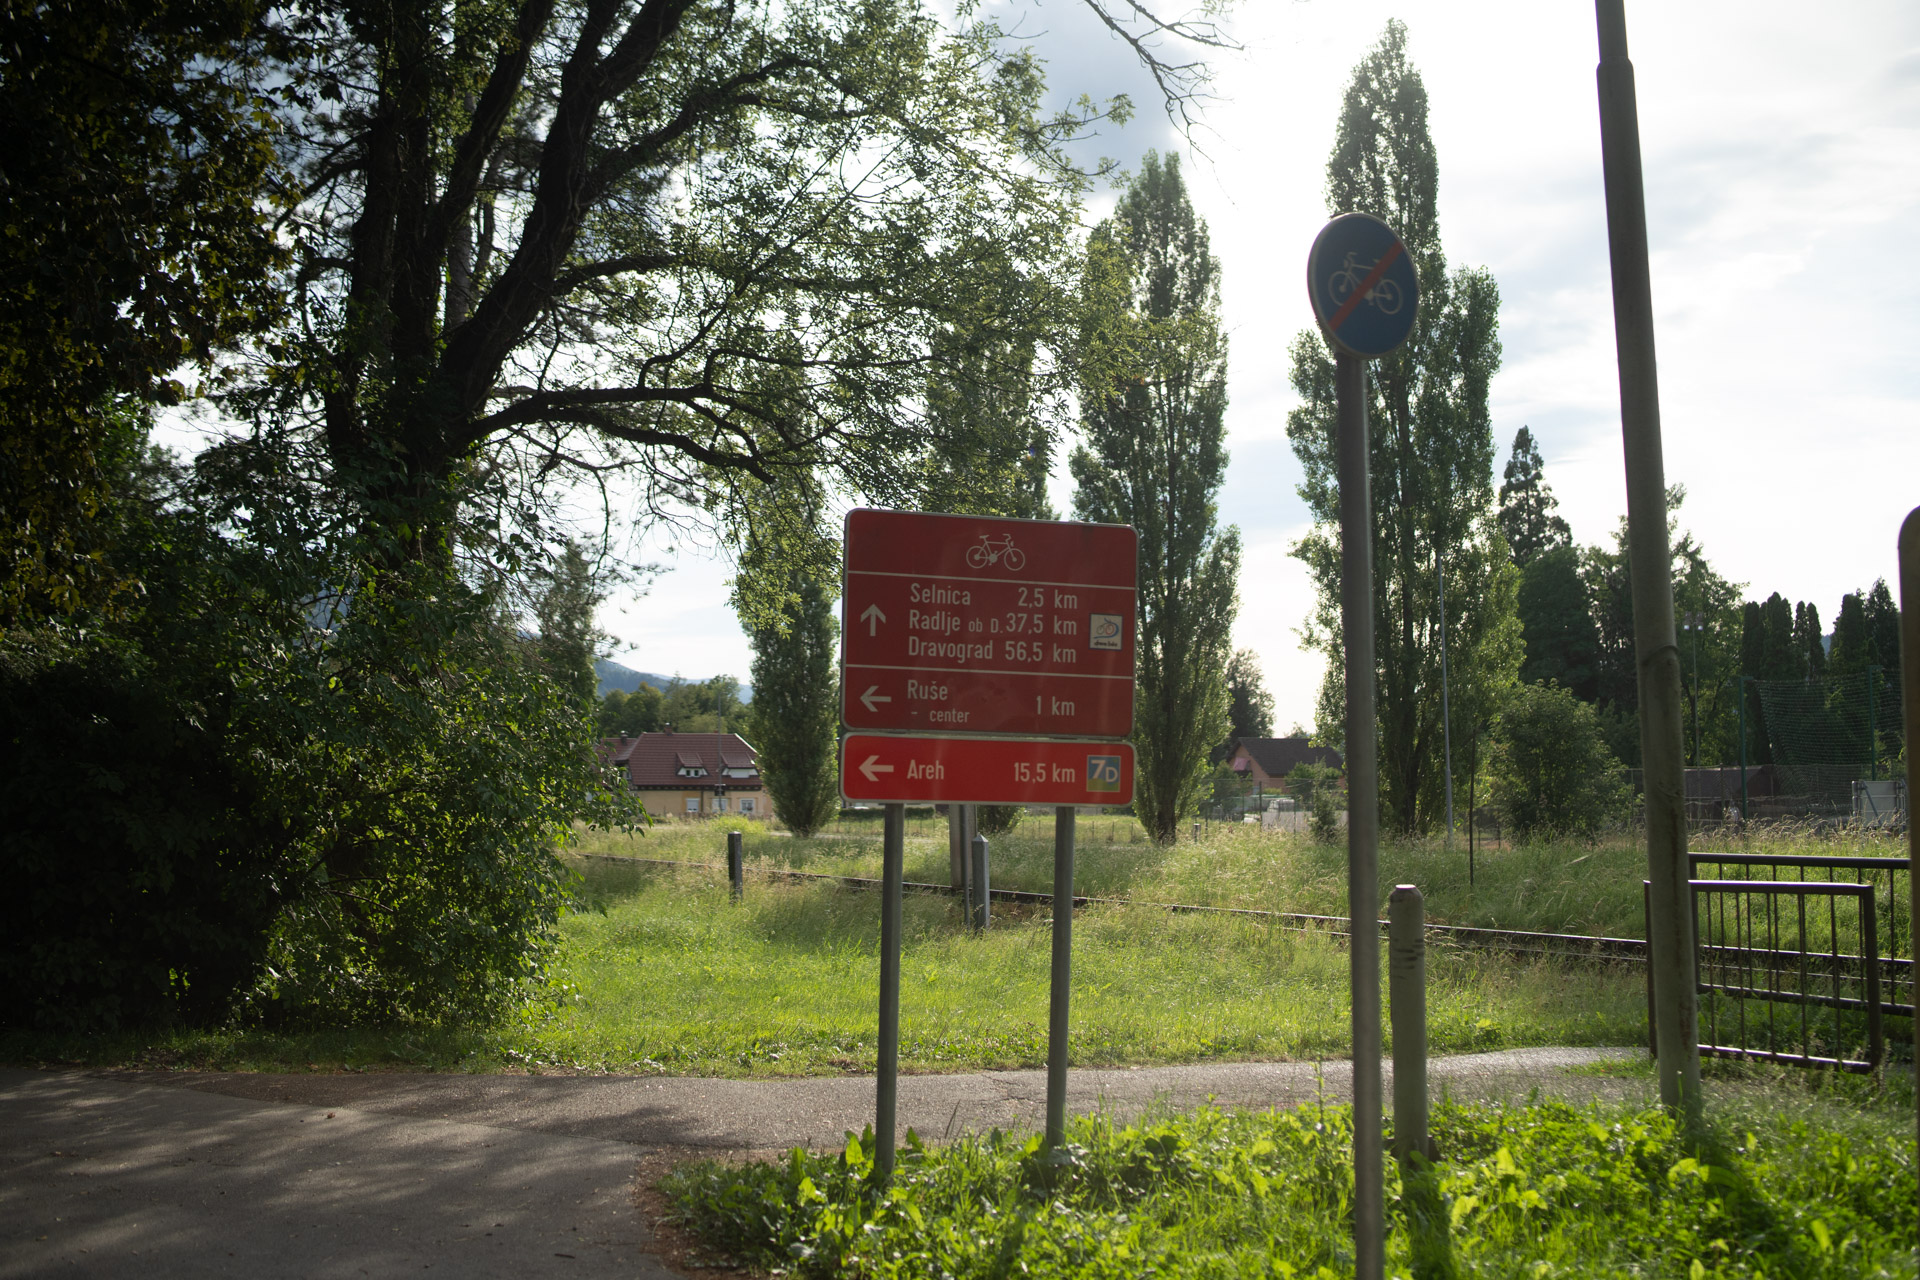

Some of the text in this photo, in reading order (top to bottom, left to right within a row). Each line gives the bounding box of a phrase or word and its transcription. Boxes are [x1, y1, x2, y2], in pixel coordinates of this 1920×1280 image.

[910, 583, 1078, 609] Selnica 2,5 km
[909, 609, 1077, 636] Radlje ob D. 37,5 km
[908, 636, 993, 664] Dravograd
[1005, 641, 1043, 662] 56,5
[1052, 643, 1076, 663] km
[907, 679, 948, 700] Ruše
[929, 708, 970, 723] center
[1036, 695, 1075, 716] 1 km
[907, 759, 1075, 784] Areh 15,5 km
[1091, 759, 1119, 782] 7D
